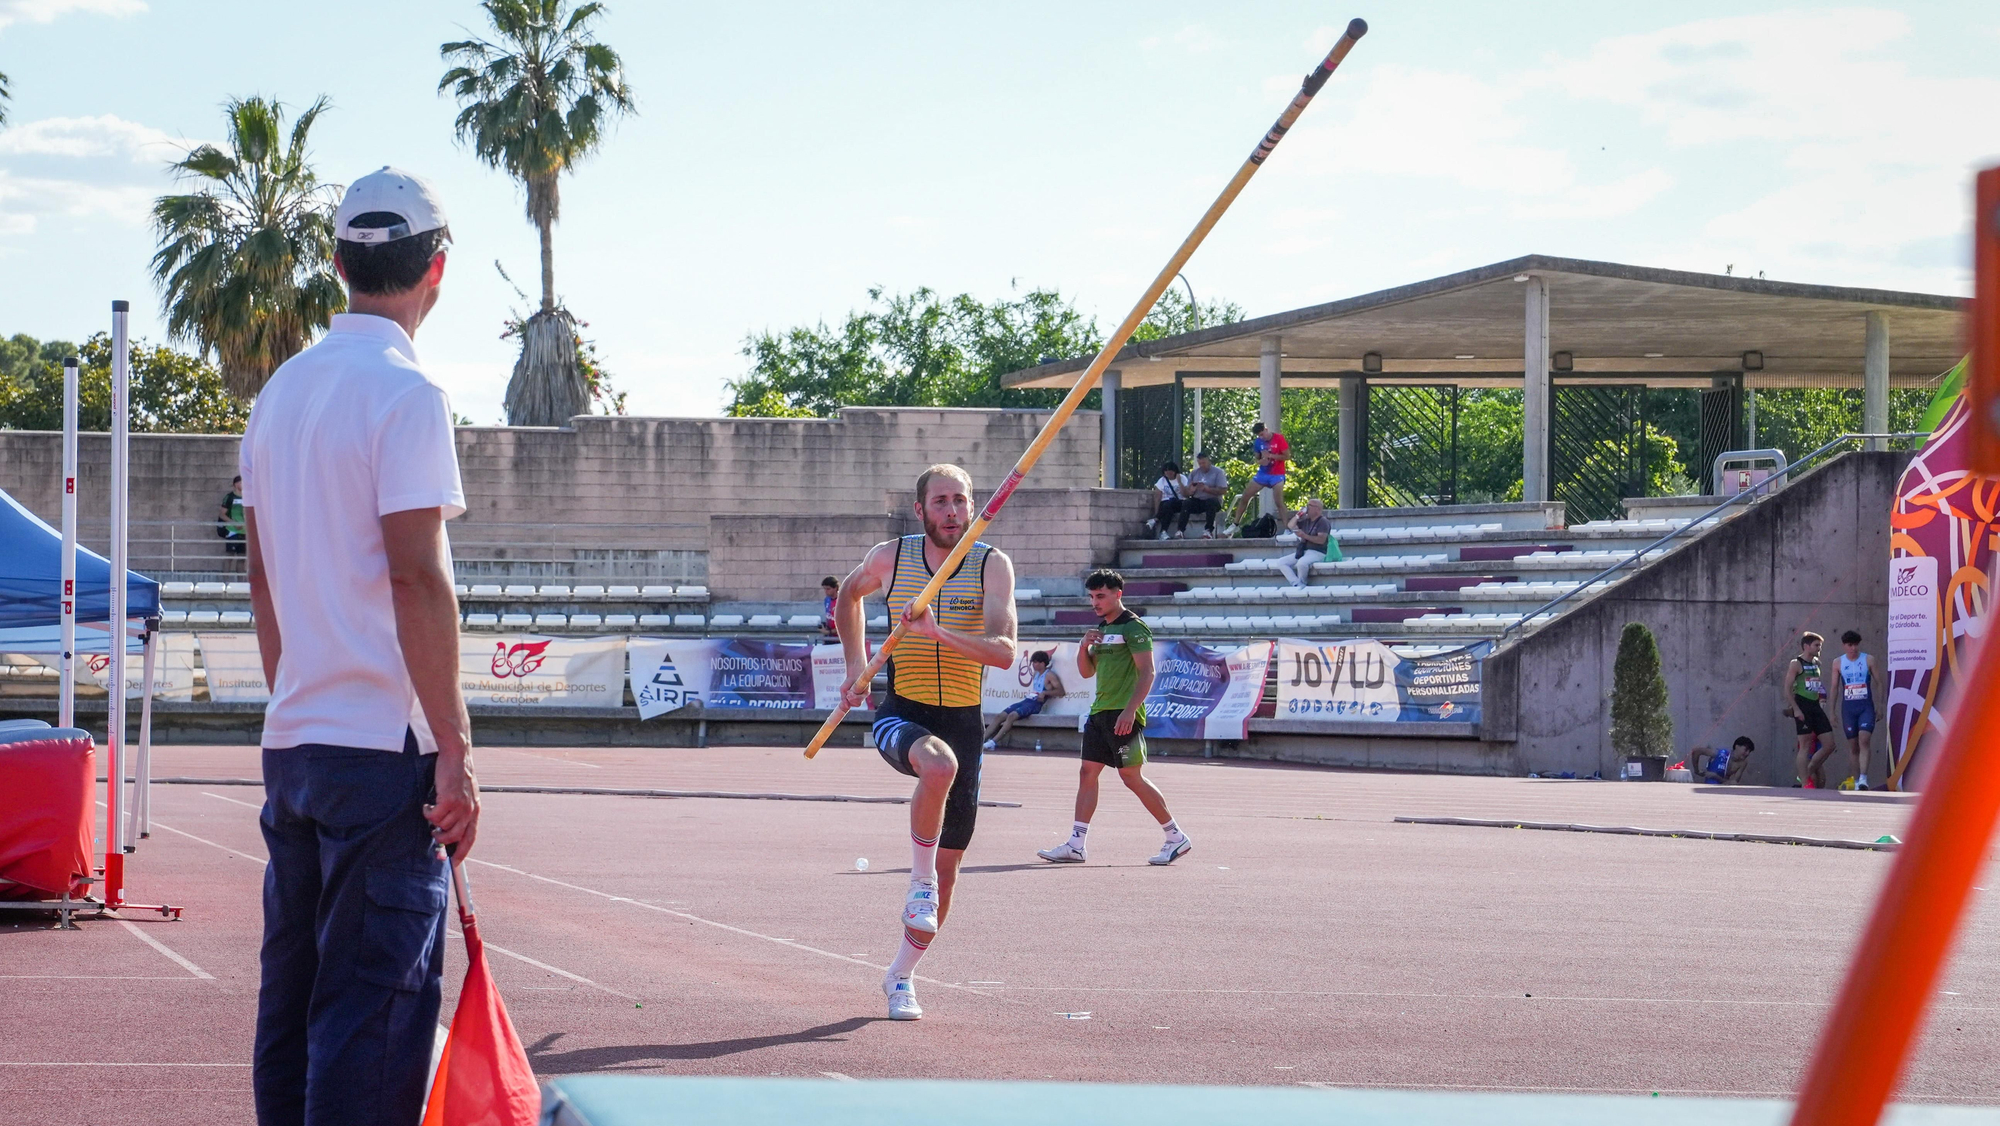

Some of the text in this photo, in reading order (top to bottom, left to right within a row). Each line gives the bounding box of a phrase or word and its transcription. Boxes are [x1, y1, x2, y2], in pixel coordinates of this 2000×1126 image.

[1890, 585, 1928, 598] MDECO
[1900, 613, 1927, 621] Deporte.
[710, 657, 802, 672] NOSOTROS PONEMOS
[1157, 659, 1192, 675] NOSOTROS
[125, 679, 174, 692] Deprtes
[219, 678, 263, 689] Instituto
[723, 673, 791, 688] LA EQUIPACIÓN
[1159, 677, 1169, 690] LA
[1413, 673, 1469, 685] DEPORTIVAS
[479, 680, 534, 693] Municipal
[538, 681, 552, 691] de
[556, 681, 607, 694] Deportes
[1407, 684, 1480, 696] PERSONALIZADAS
[491, 693, 539, 704] Córdoba
[984, 688, 1010, 699] tituto
[1064, 690, 1090, 701] eportes
[913, 891, 932, 899] NIKE
[896, 982, 910, 991] NIKE
